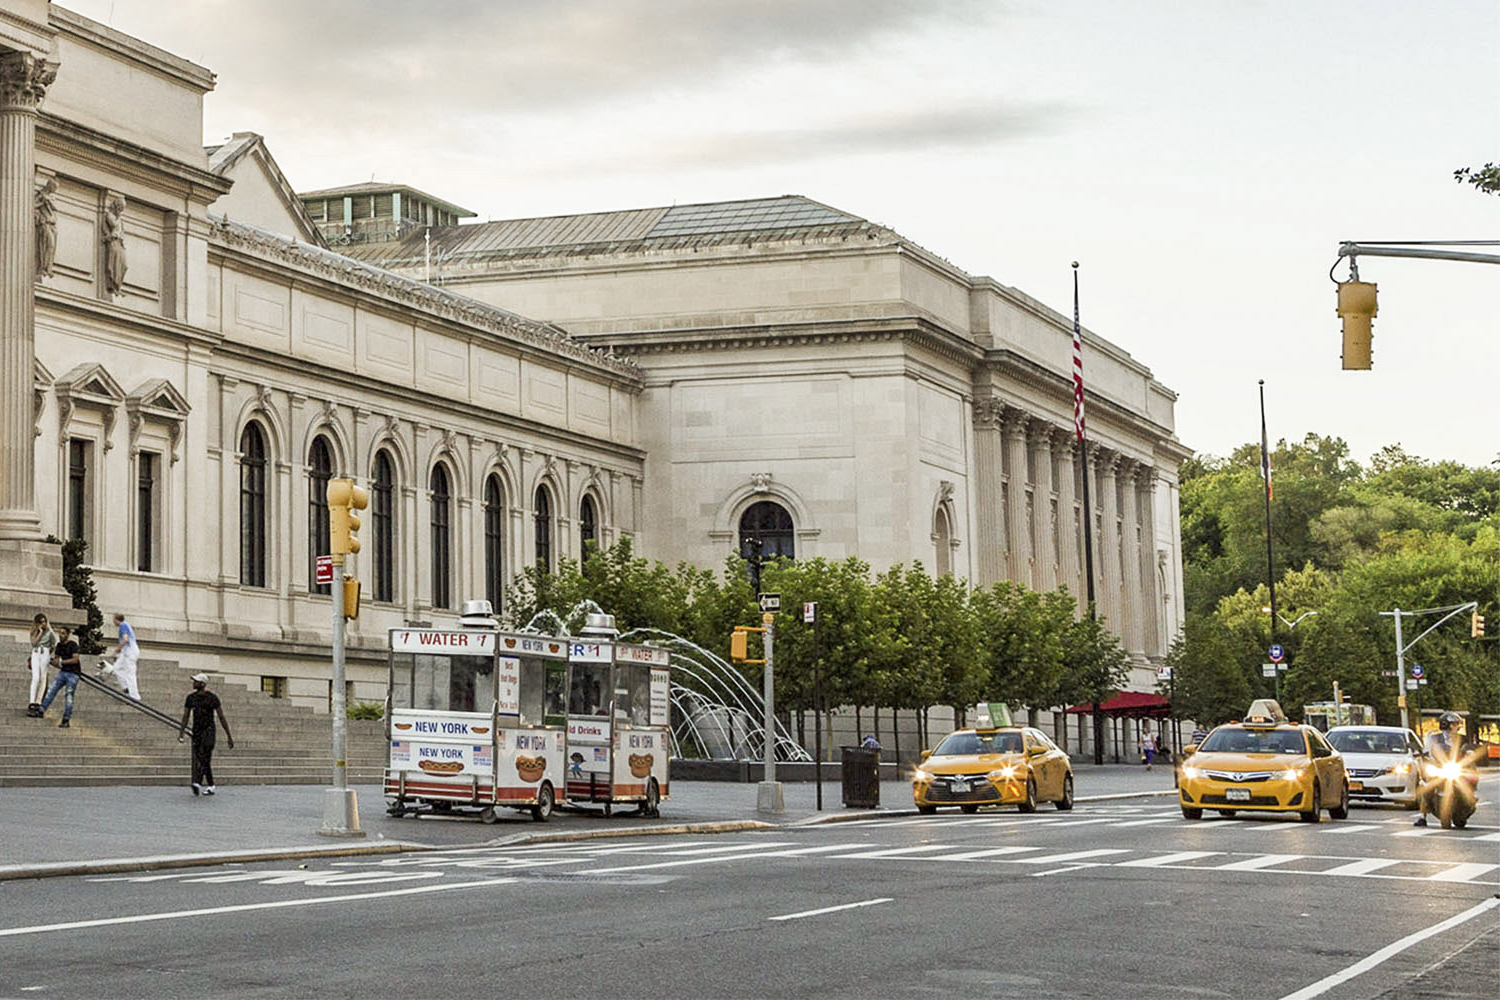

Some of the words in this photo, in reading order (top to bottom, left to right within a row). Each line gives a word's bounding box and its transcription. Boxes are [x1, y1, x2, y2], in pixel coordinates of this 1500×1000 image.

[419, 632, 468, 646] WATER
[415, 721, 438, 733] NEW
[440, 722, 468, 735] YORK
[577, 725, 602, 736] Drinks
[516, 735, 530, 750] NEW
[530, 736, 547, 751] YORK
[629, 735, 641, 749] NEW
[641, 735, 654, 749] YORK
[419, 747, 438, 758] NEW
[439, 748, 464, 759] YORK
